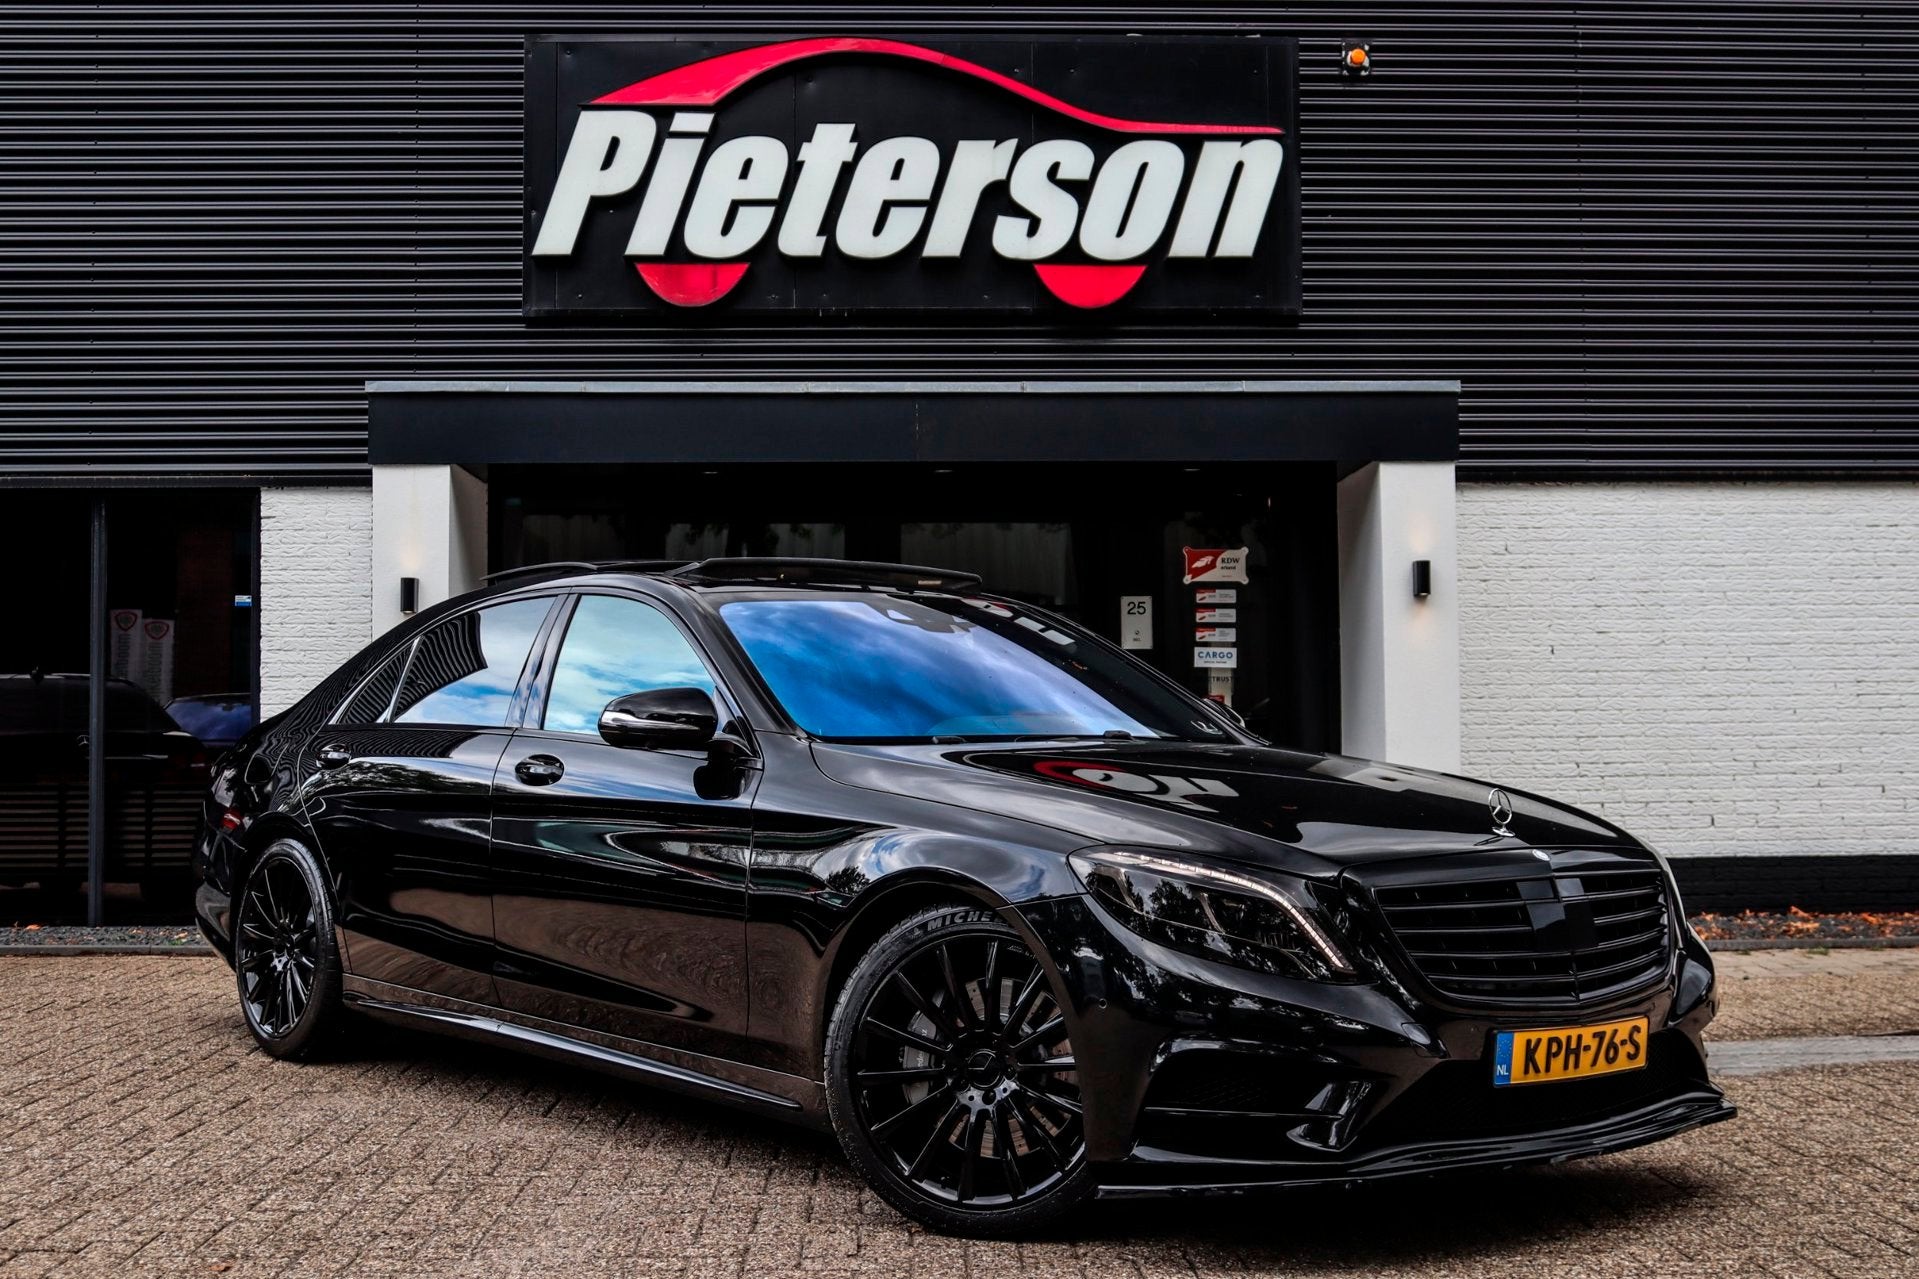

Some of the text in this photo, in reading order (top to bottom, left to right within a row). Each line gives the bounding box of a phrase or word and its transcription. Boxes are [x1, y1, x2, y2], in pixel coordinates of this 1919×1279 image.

[531, 109, 1284, 260] Pieterson
[1127, 601, 1147, 615] 25
[1197, 651, 1234, 659] CARGO
[1523, 1024, 1642, 1076] KPH-76-S
[1496, 1064, 1509, 1076] NL
